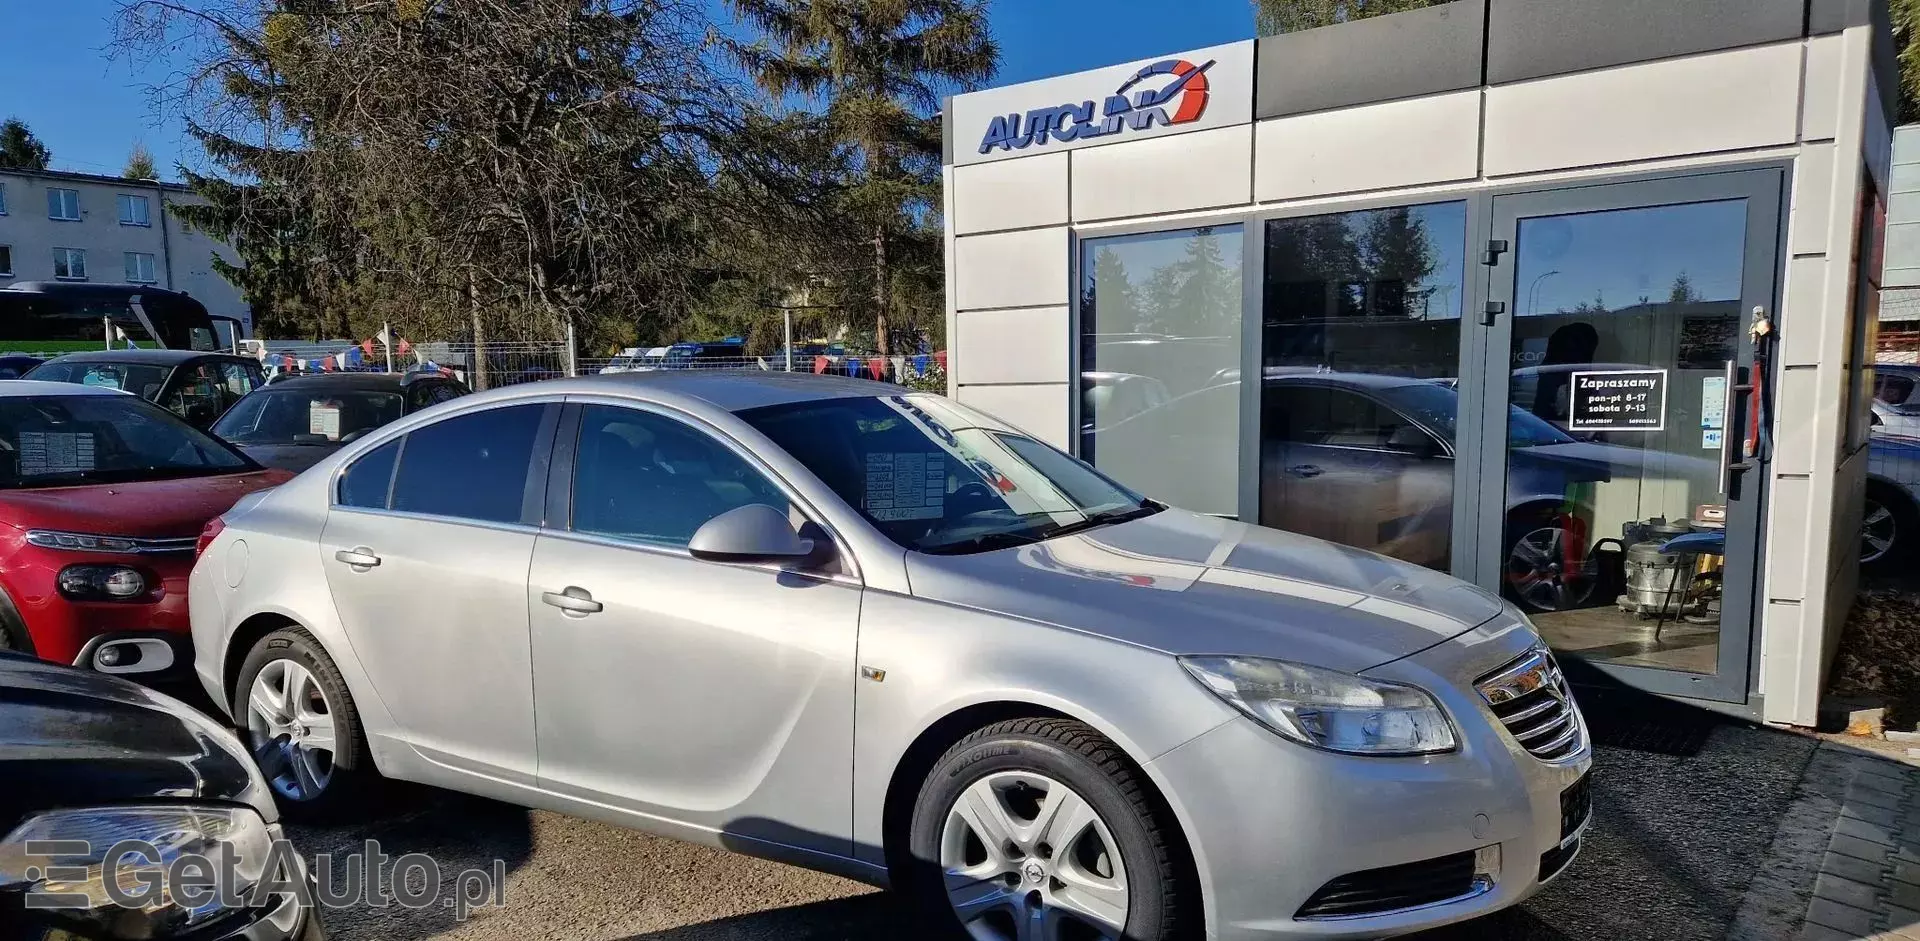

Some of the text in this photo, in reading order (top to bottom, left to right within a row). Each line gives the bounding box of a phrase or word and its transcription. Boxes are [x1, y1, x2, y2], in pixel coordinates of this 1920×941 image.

[978, 84, 1176, 155] AUTOLINK
[1580, 378, 1656, 390] Zapraszamy
[1588, 393, 1647, 404] pon-pt 8-17
[1624, 404, 1646, 412] 9-13
